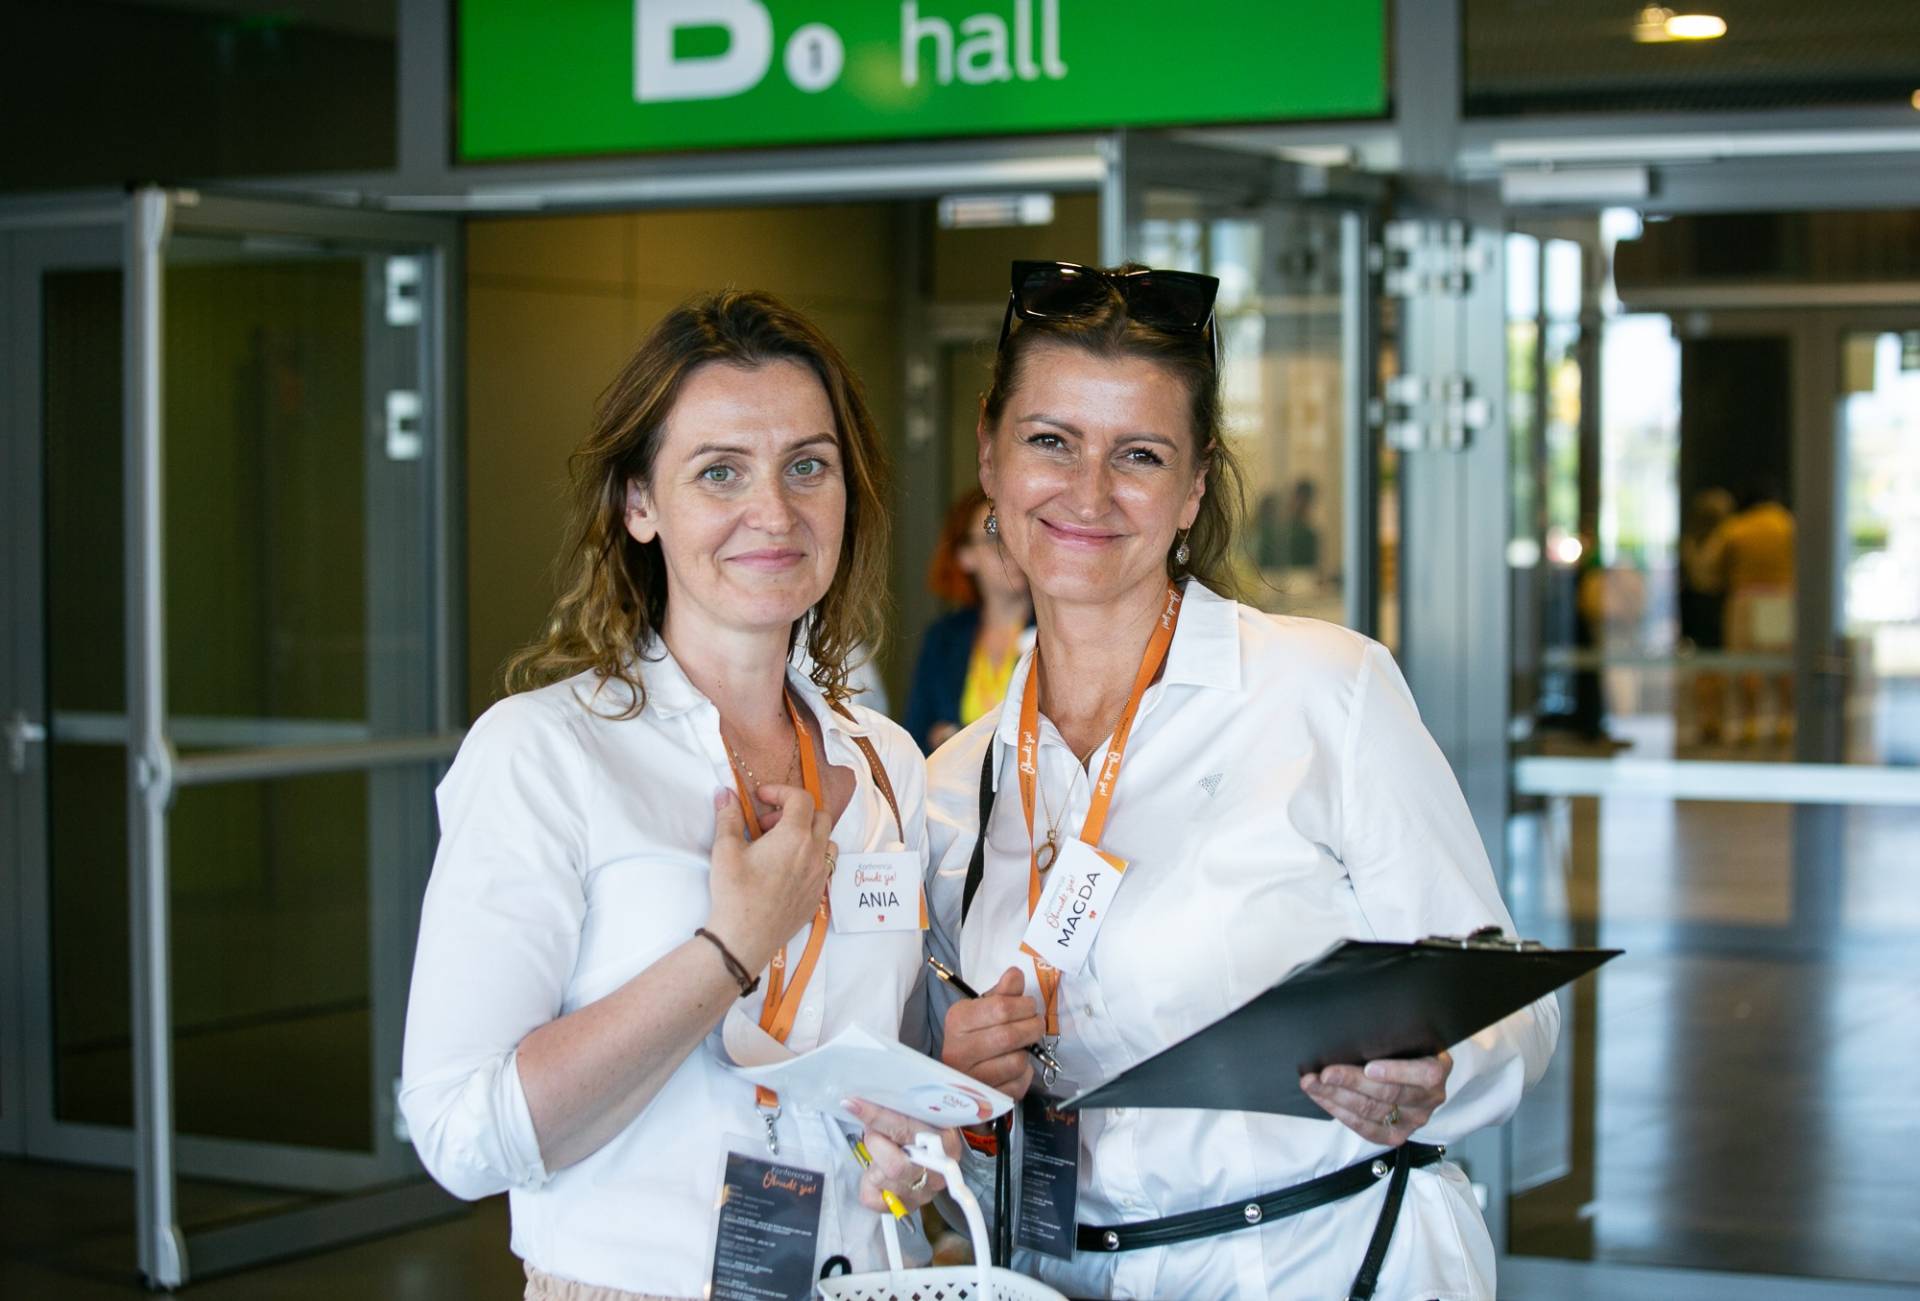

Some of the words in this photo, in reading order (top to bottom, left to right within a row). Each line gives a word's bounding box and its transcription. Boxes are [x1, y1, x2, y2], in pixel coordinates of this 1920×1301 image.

[902, 0, 1068, 88] hall
[858, 891, 900, 909] ANIA
[1057, 872, 1101, 948] MAGDA
